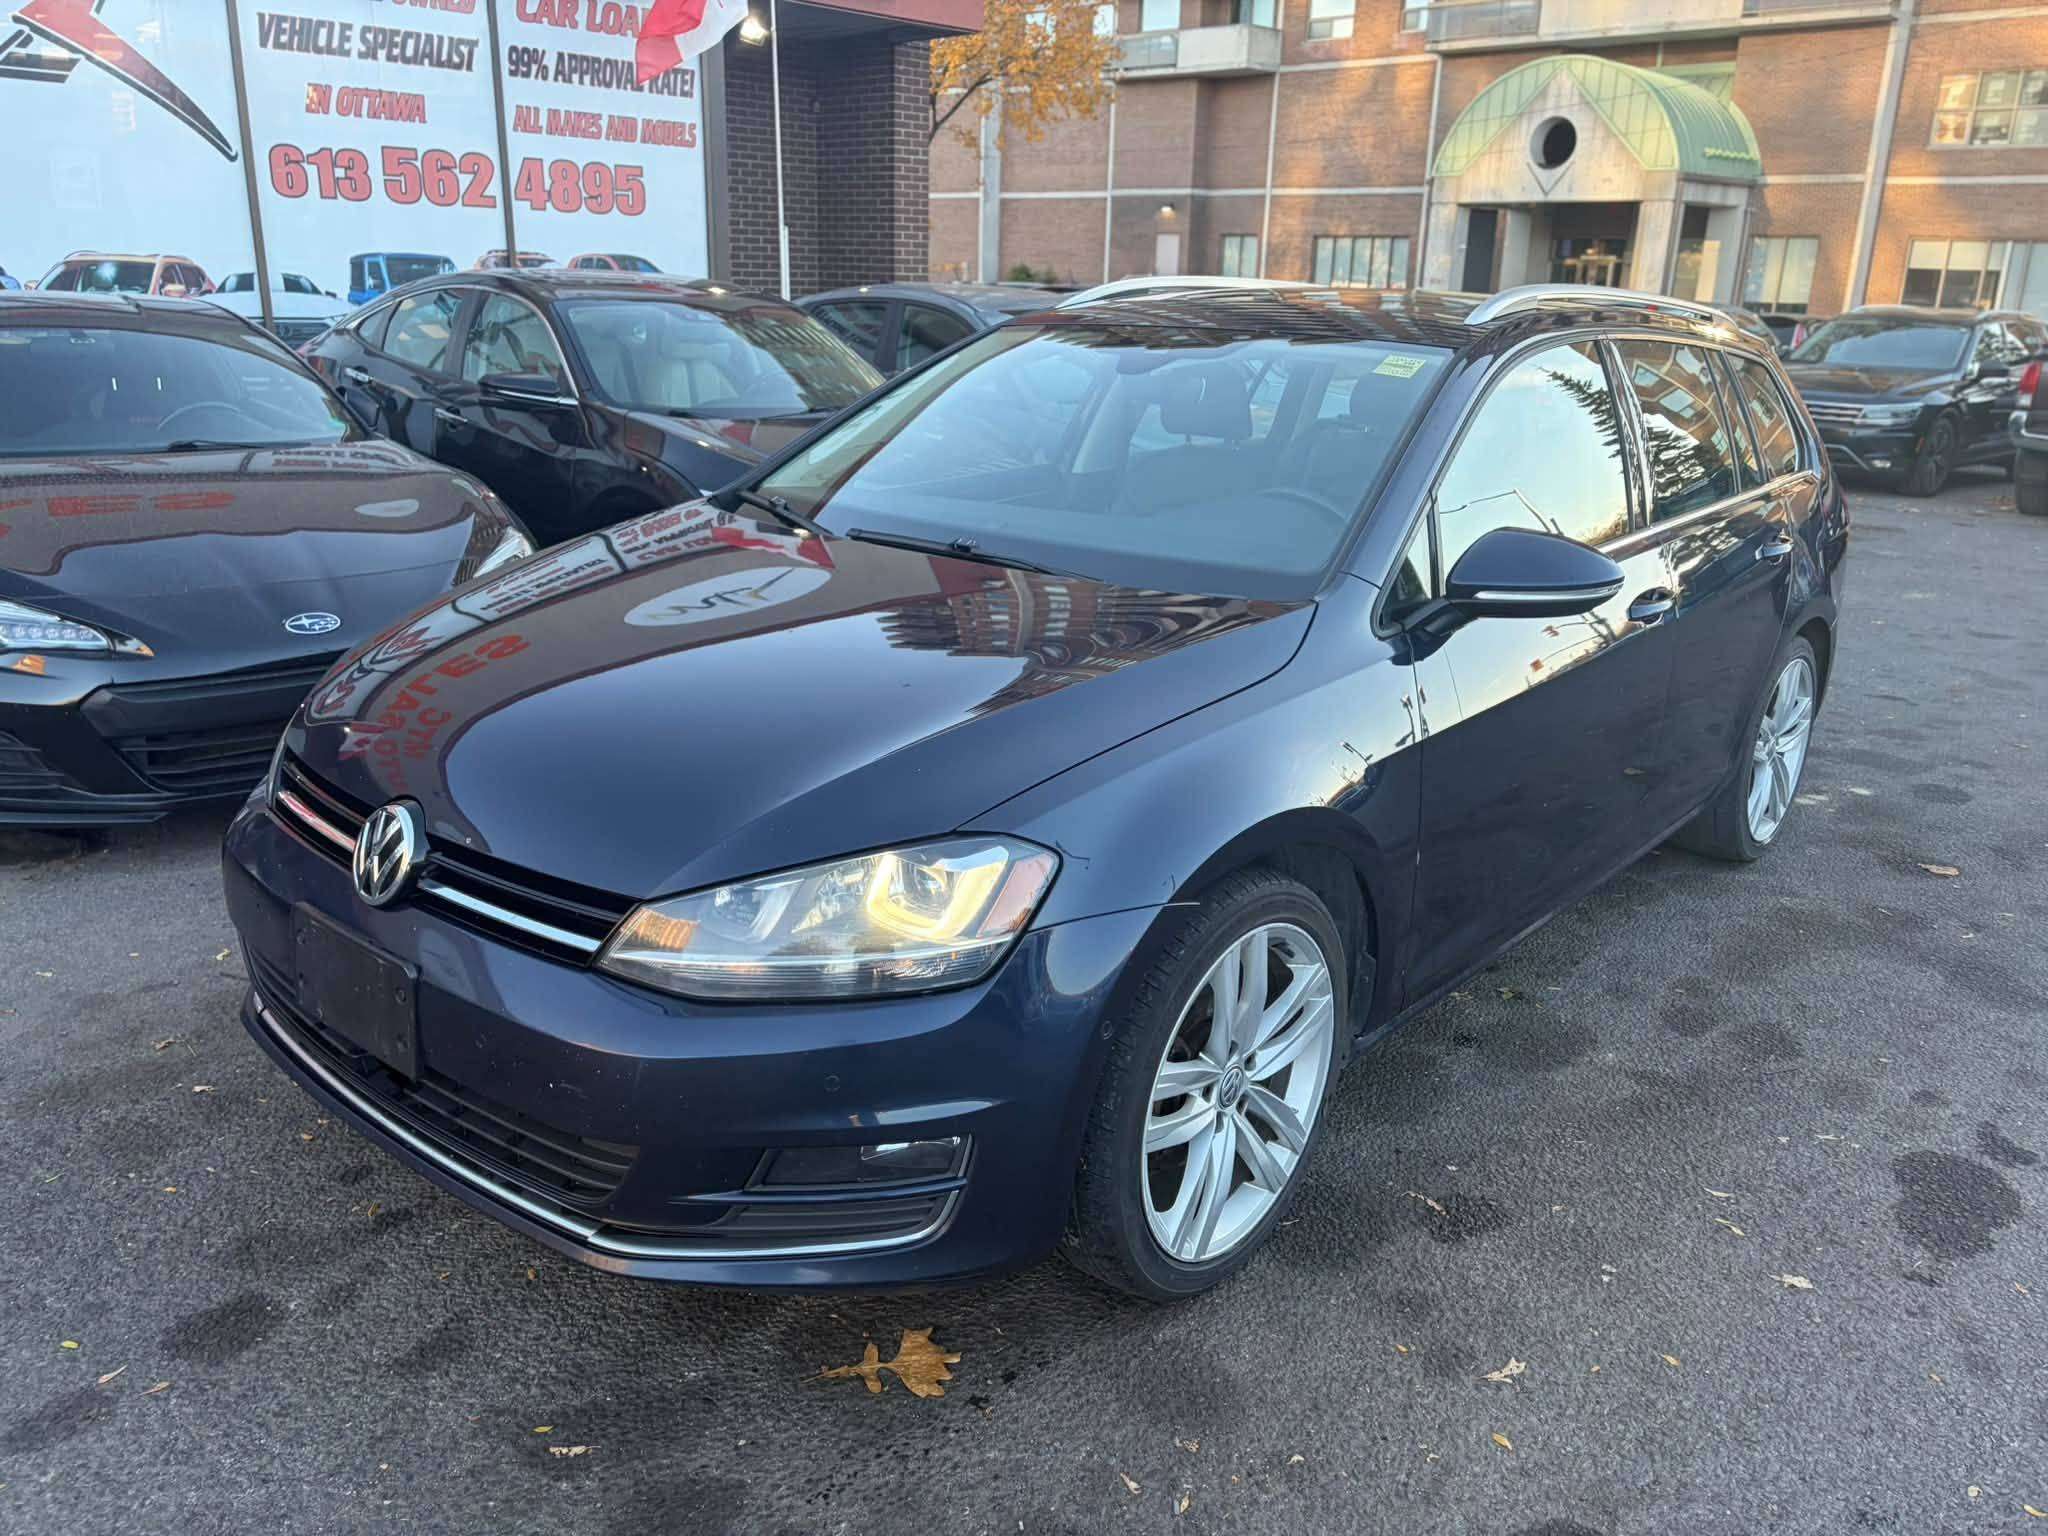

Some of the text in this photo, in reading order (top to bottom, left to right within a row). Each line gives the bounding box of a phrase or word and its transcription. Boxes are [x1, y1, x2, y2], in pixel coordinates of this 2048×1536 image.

[256, 12, 479, 71] VEHICLE SPECIALIST
[515, 0, 579, 29] CAR
[586, 0, 651, 39] LOA
[508, 45, 549, 81] 99%
[553, 52, 644, 92] APPROVA
[305, 82, 427, 124] IN OTTAWA
[512, 104, 697, 149] ALL MAKES AND MODELS
[269, 143, 646, 216] 613 562 4895
